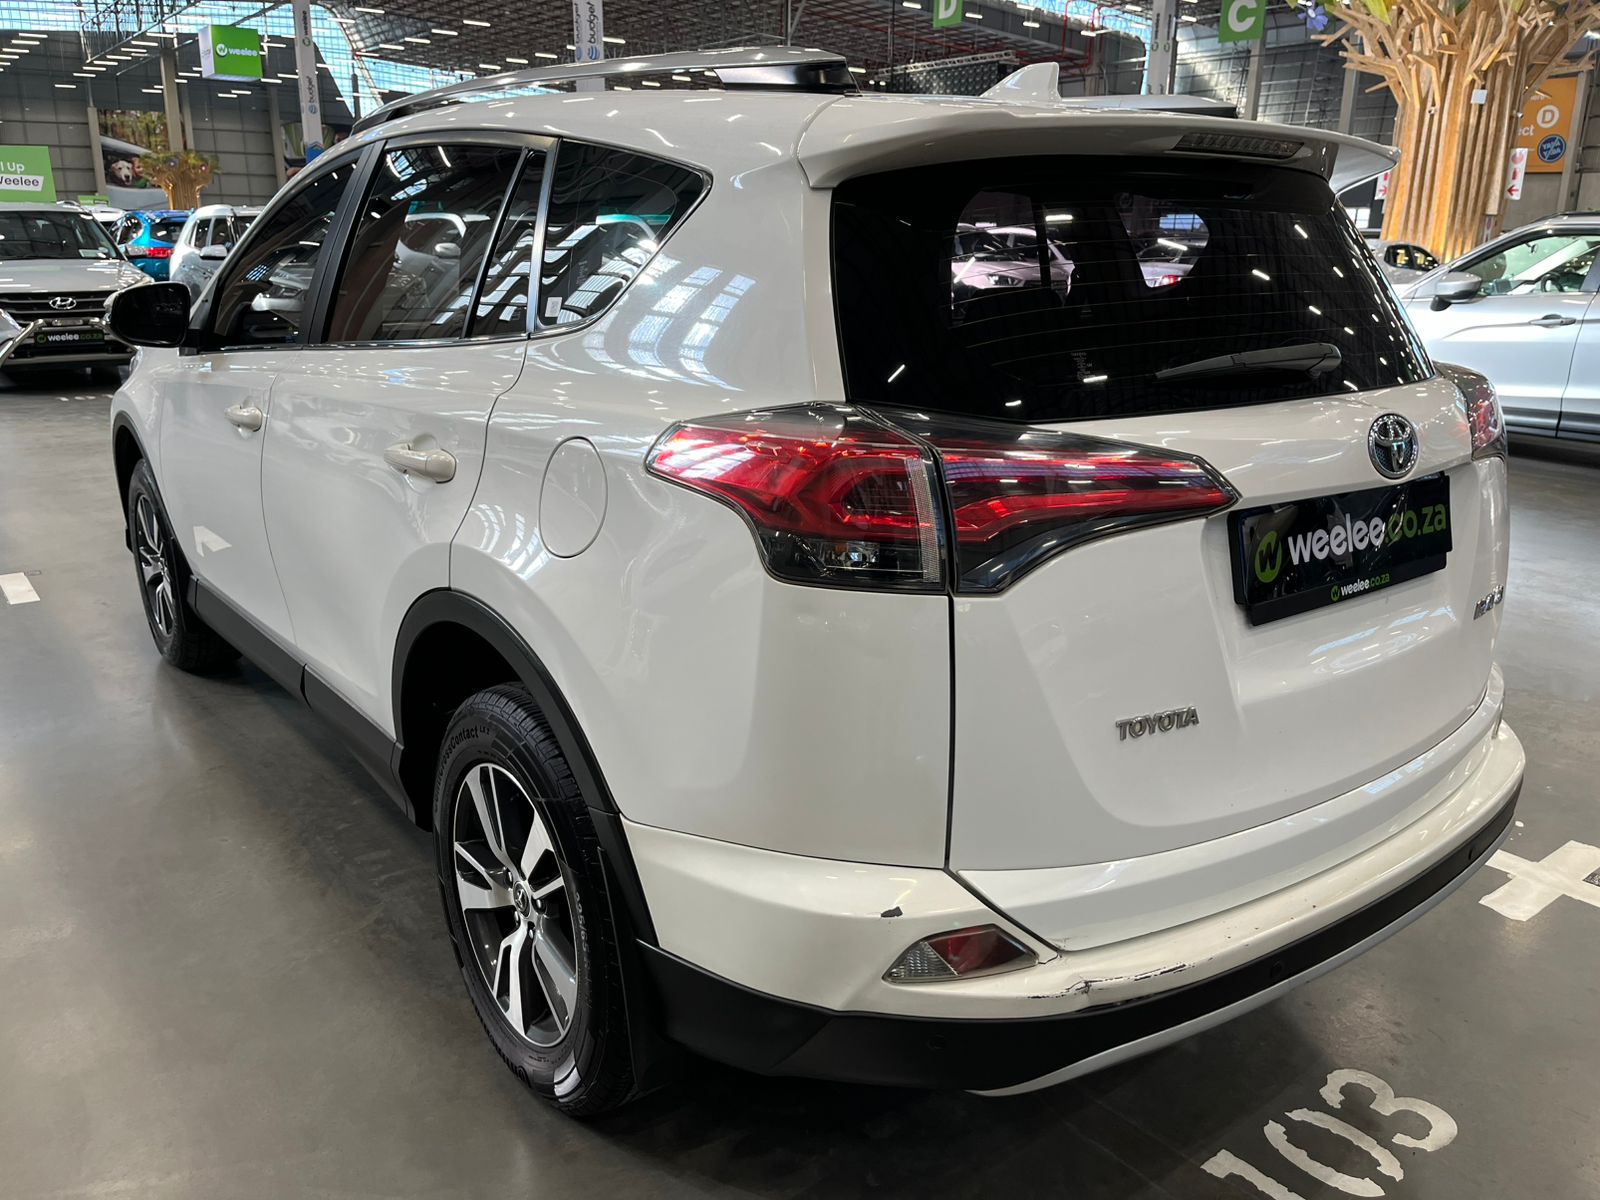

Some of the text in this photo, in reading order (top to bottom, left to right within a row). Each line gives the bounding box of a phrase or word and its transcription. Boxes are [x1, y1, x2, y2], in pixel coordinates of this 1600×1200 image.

[587, 2, 598, 44] budget
[1227, 0, 1257, 33] C
[7, 162, 25, 174] Up
[1340, 573, 1390, 596] weelee.co.za
[1115, 705, 1200, 741] TOYOTA
[1200, 1068, 1458, 1200] 103
